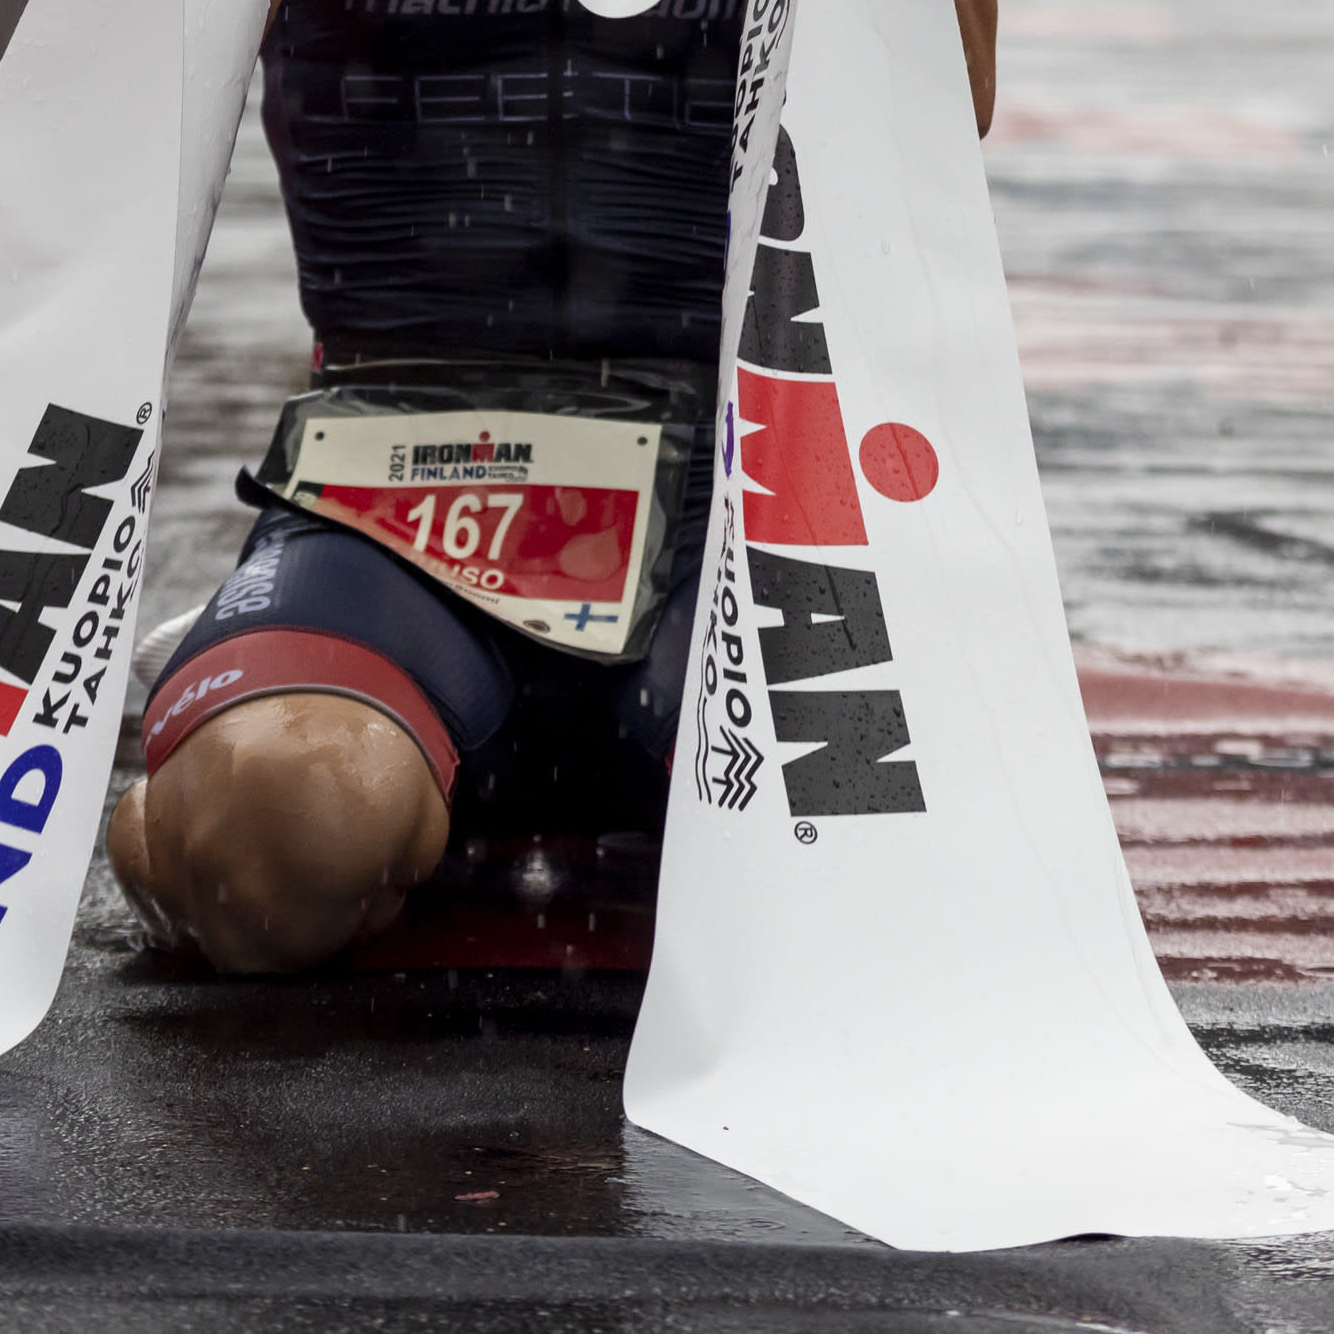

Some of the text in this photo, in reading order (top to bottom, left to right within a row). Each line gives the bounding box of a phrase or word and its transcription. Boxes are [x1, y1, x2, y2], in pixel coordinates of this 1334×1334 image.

[389, 445, 406, 482] 2021
[411, 466, 487, 481] FINLAND
[412, 434, 533, 465] IRONMAN
[407, 493, 524, 560] 167
[32, 516, 136, 729] KUOPIO
[63, 538, 142, 734] TAHKO
